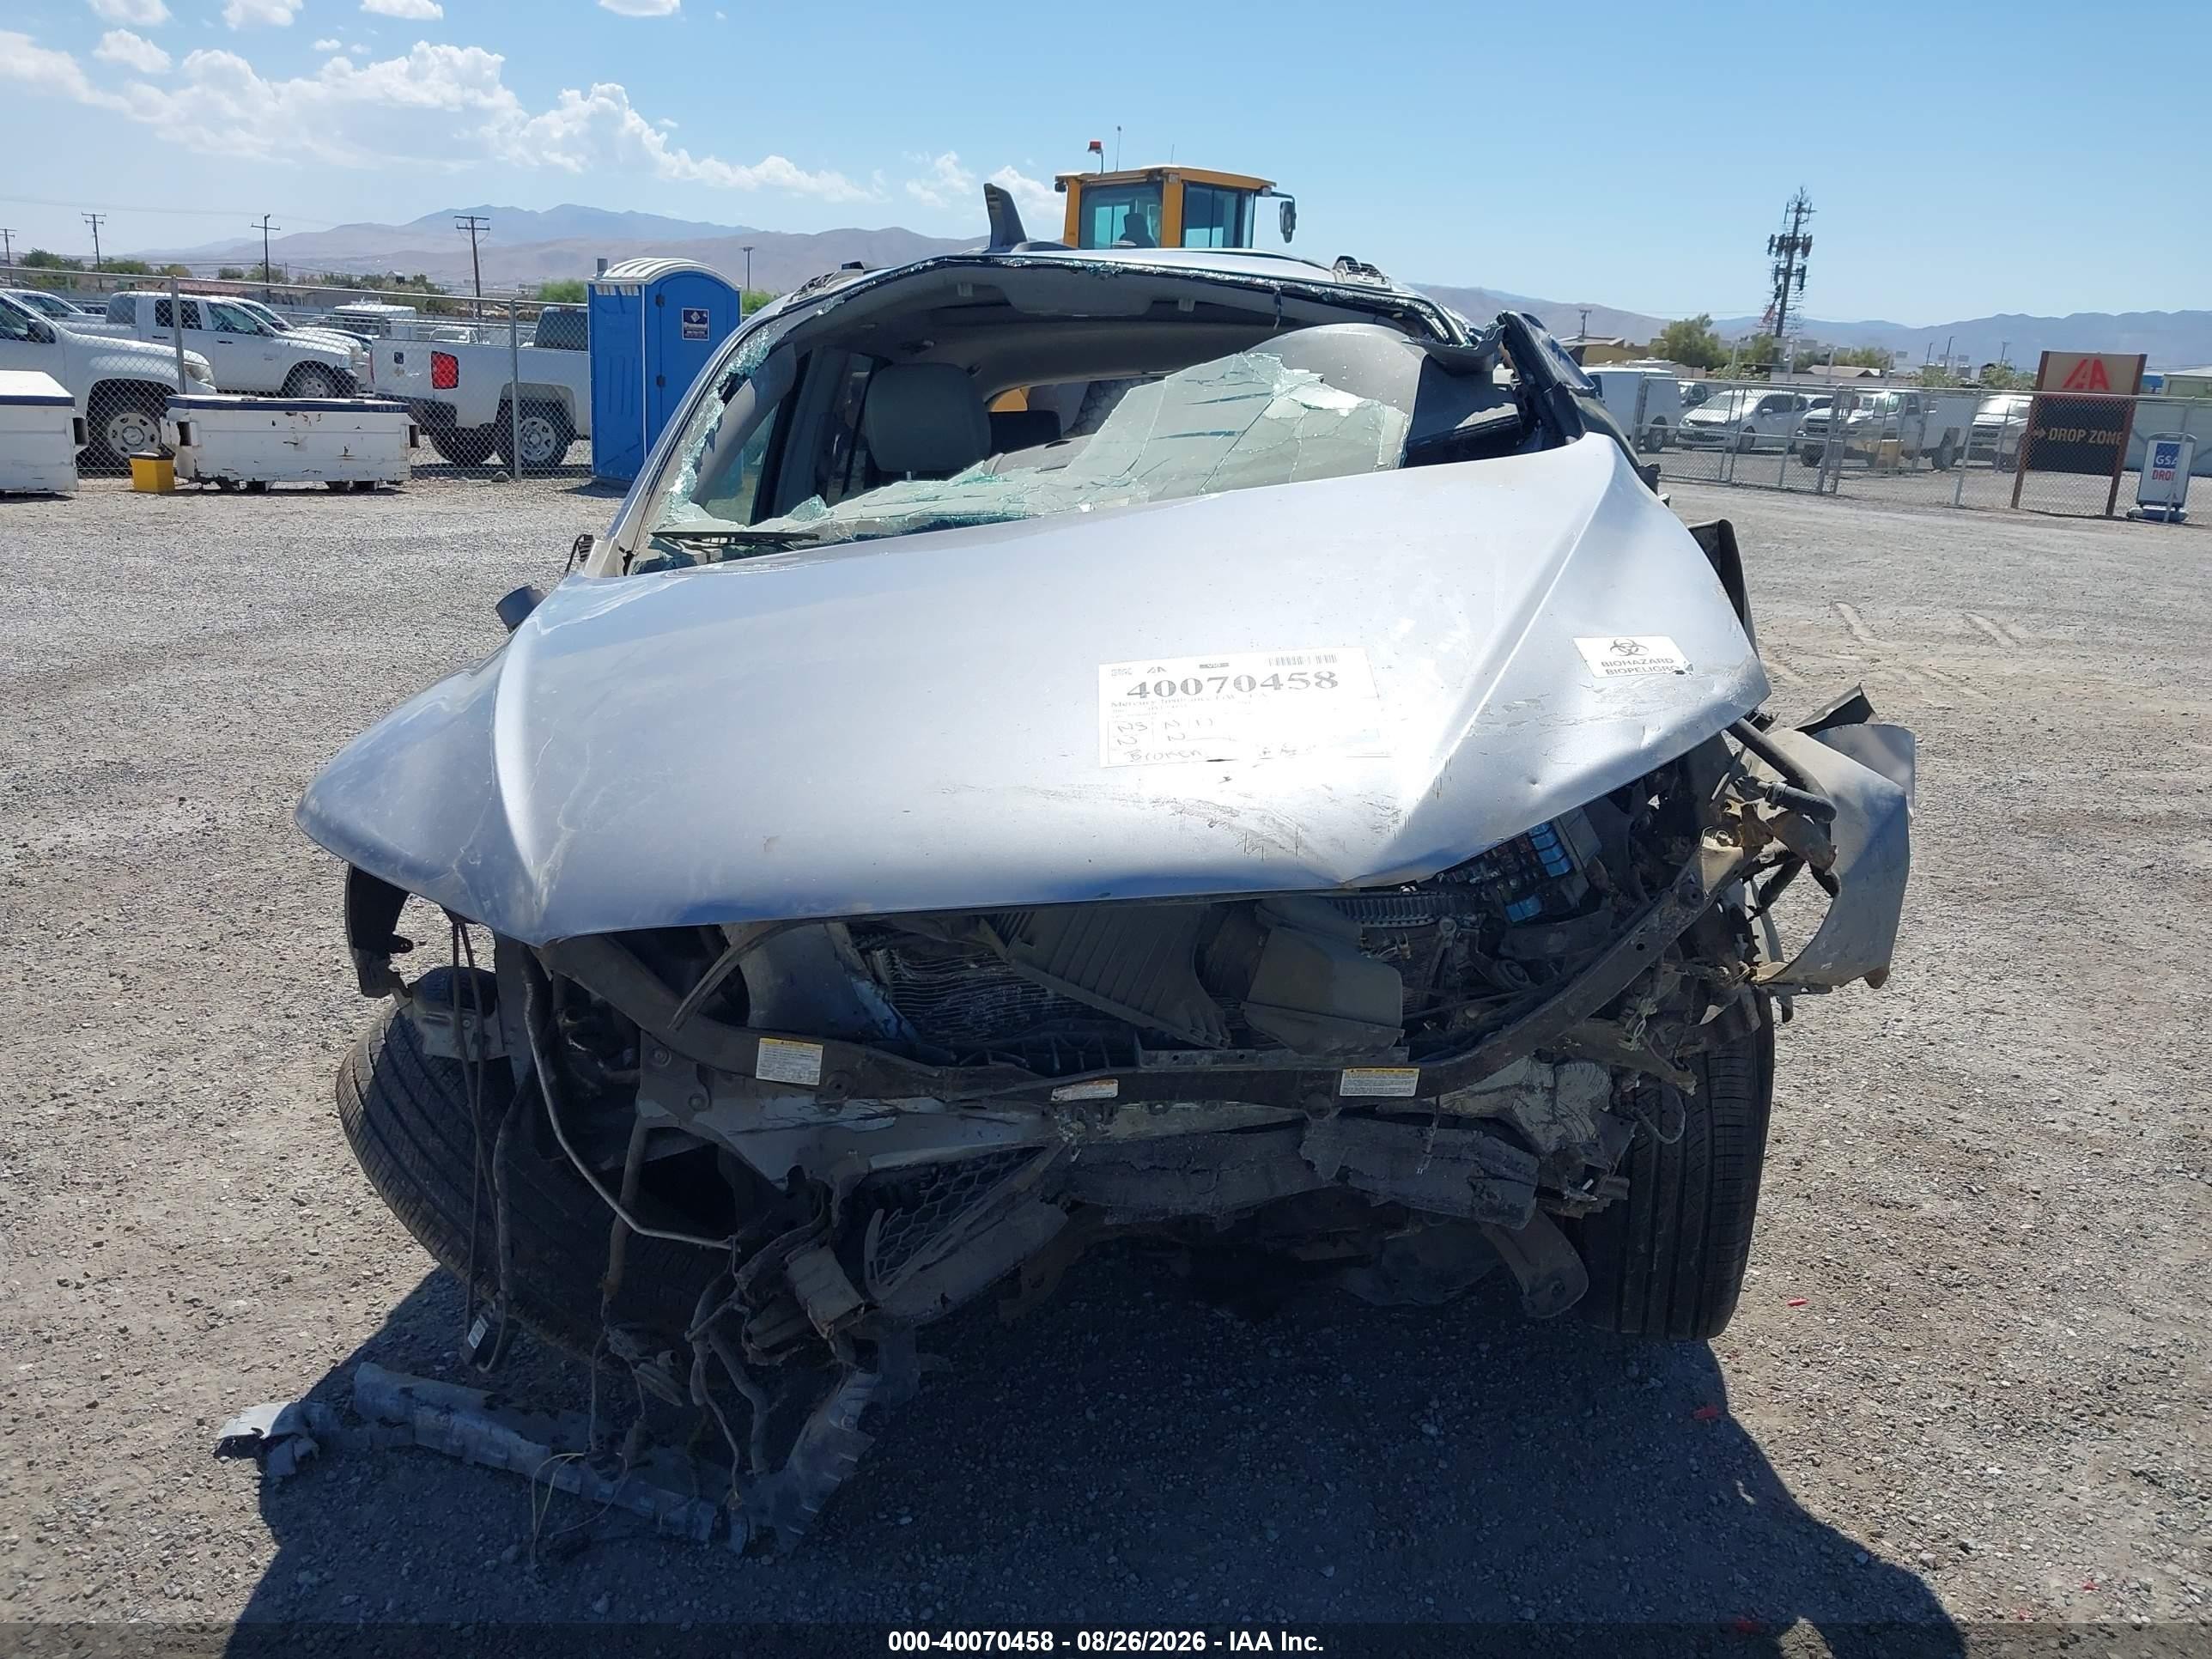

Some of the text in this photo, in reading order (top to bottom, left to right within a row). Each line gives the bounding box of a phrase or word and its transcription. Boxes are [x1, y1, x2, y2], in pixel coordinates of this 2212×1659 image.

[2049, 428, 2123, 445] DROP ZONE
[1601, 658, 1674, 667] BIOHAZARD
[1127, 671, 1338, 699] 40070458
